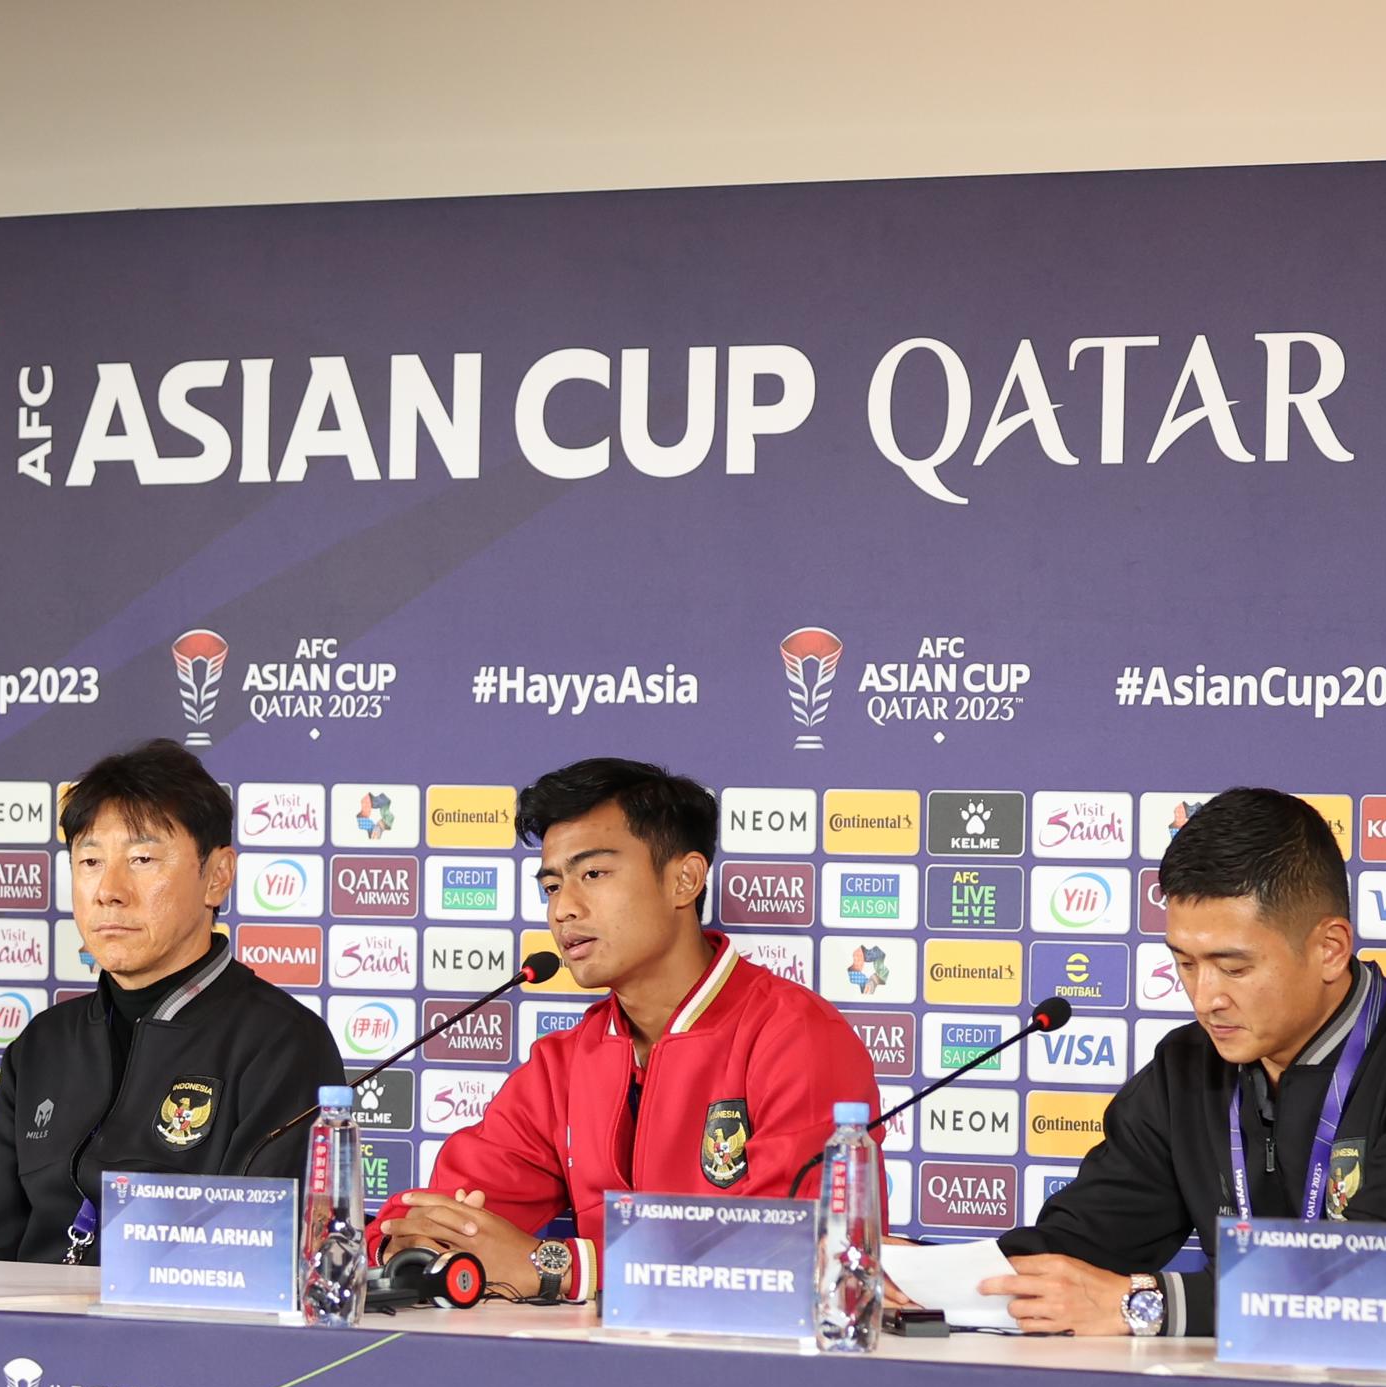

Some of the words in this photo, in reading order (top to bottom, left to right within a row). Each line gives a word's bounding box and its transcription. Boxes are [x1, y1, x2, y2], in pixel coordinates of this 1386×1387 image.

[18, 366, 53, 486] AFC
[66, 353, 481, 486] ASIAN
[515, 345, 815, 479] CUP
[868, 333, 1354, 504] QATAR
[295, 639, 337, 658] AFC
[918, 637, 964, 658] AFC
[242, 664, 330, 691] ASIAN
[336, 663, 396, 691] CUP
[859, 664, 956, 692] ASIAN
[963, 664, 1030, 692] CUP
[472, 664, 697, 714] #HayyaAsia
[250, 695, 323, 723] QATAR
[868, 696, 948, 725] QATAR
[274, 794, 300, 810] Visit
[1074, 803, 1103, 816] Visit
[432, 809, 498, 826] Continental
[951, 838, 999, 849] KELME
[338, 869, 409, 895] QATAR
[447, 870, 492, 885] CREDIT
[953, 872, 978, 884] AFC
[356, 892, 409, 905] AIRWAYS
[952, 886, 996, 905] LIVE
[242, 946, 316, 964] KONAMI
[433, 950, 504, 970] NEOM
[1056, 986, 1101, 997] FOOTBALL
[1038, 1034, 1115, 1066] VISA
[928, 1176, 1006, 1203] QATAR
[948, 1201, 1006, 1215] AIRWAYS
[124, 1223, 207, 1243] PRATAMA
[211, 1228, 272, 1247] ARHAN
[150, 1267, 245, 1288] INDONESIA
[625, 1263, 794, 1292] INTERPRETER
